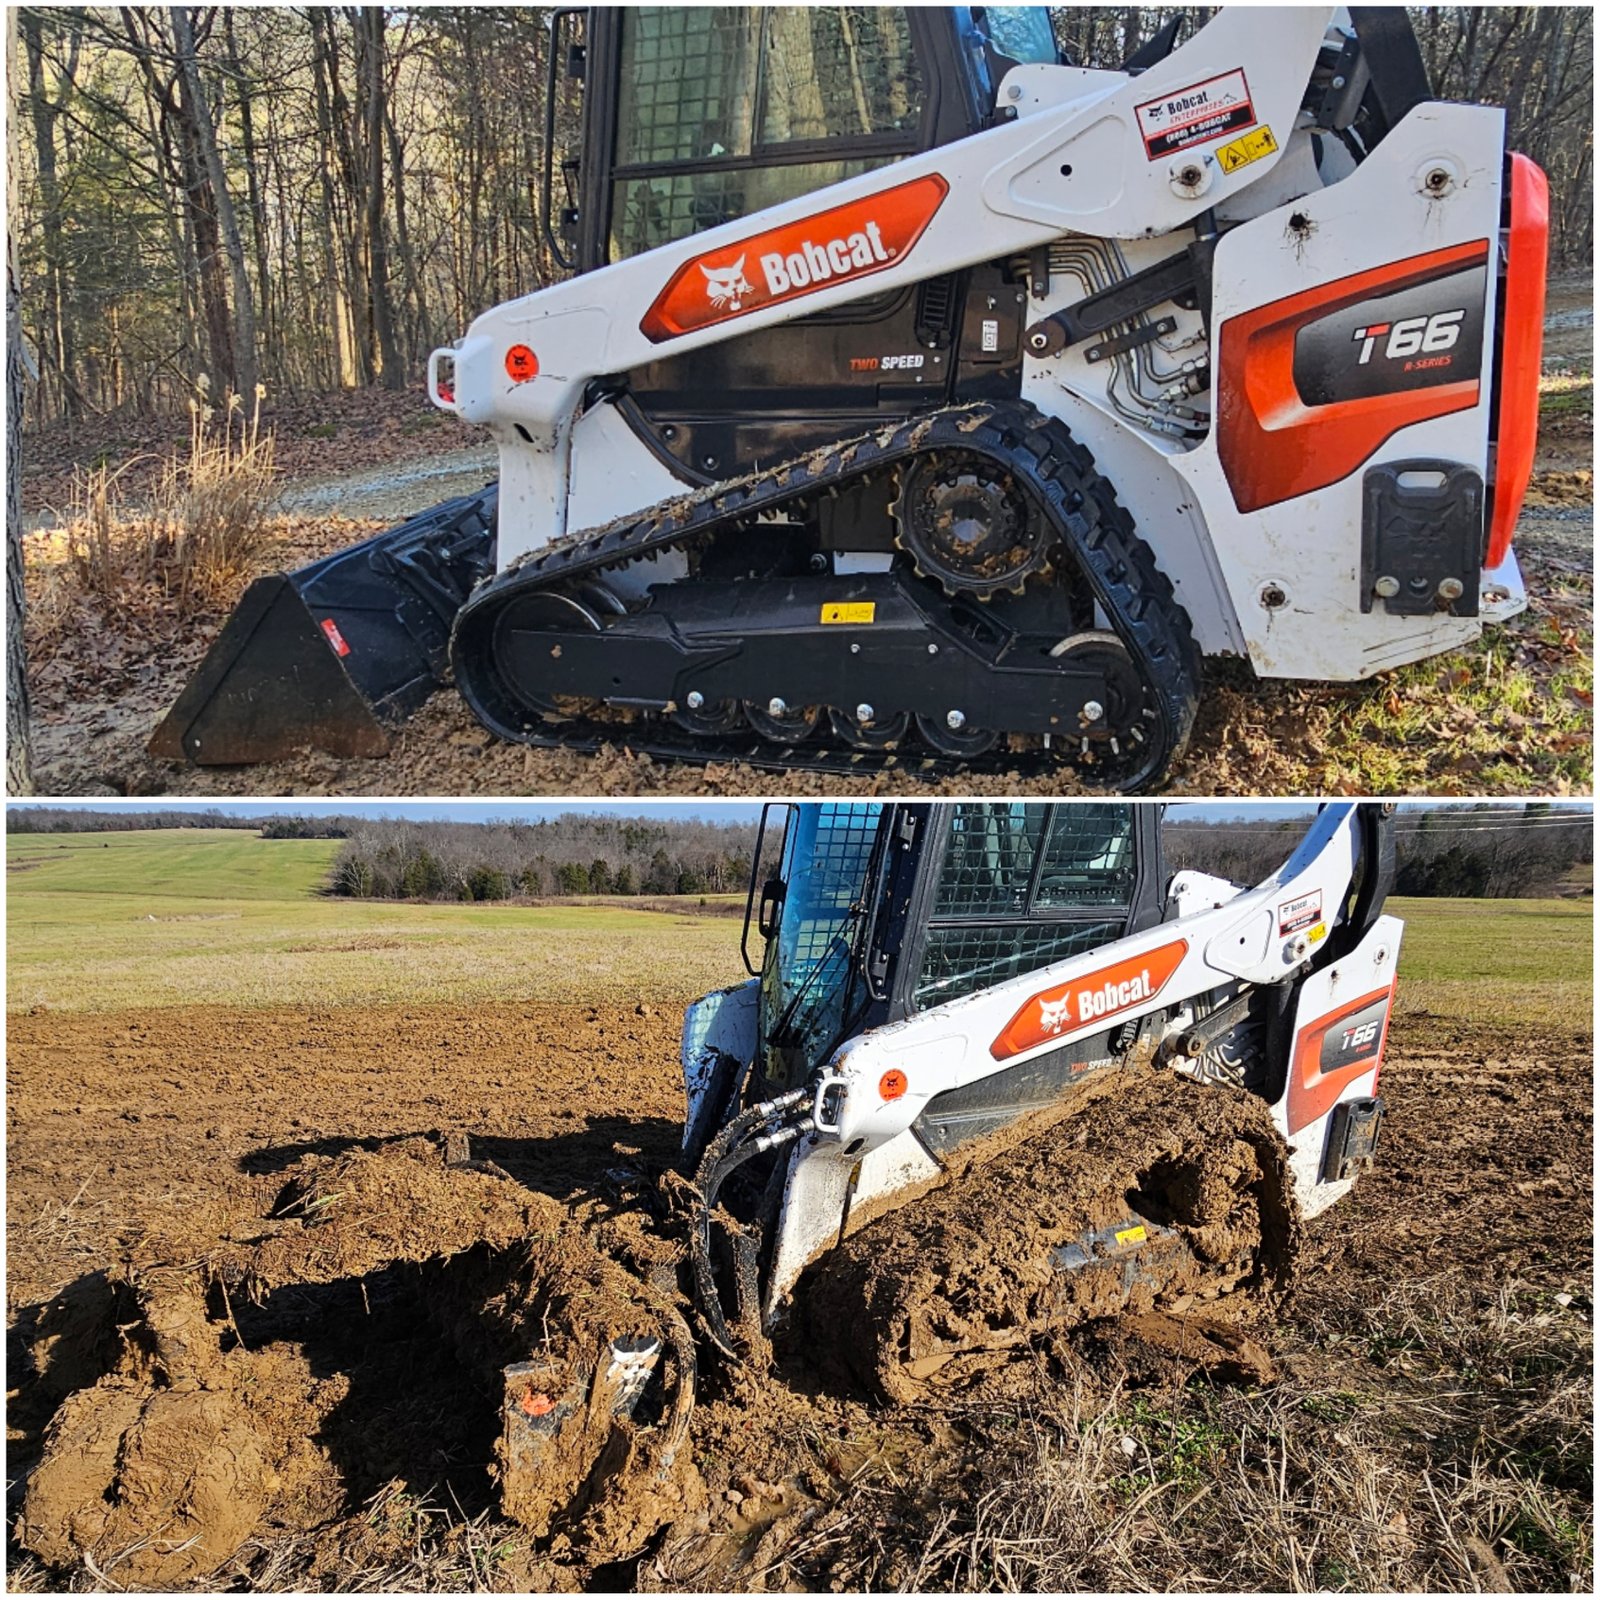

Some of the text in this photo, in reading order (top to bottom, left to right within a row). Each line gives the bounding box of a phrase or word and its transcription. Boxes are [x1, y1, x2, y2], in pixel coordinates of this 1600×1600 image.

[1167, 91, 1209, 116] Bobcat
[760, 221, 889, 296] Bobcat
[1353, 309, 1465, 365] T66
[849, 354, 924, 371] TWO SPEED
[1403, 355, 1453, 372] R-SERIES
[1078, 969, 1151, 1022] Bobcat
[1341, 1020, 1379, 1050] T66
